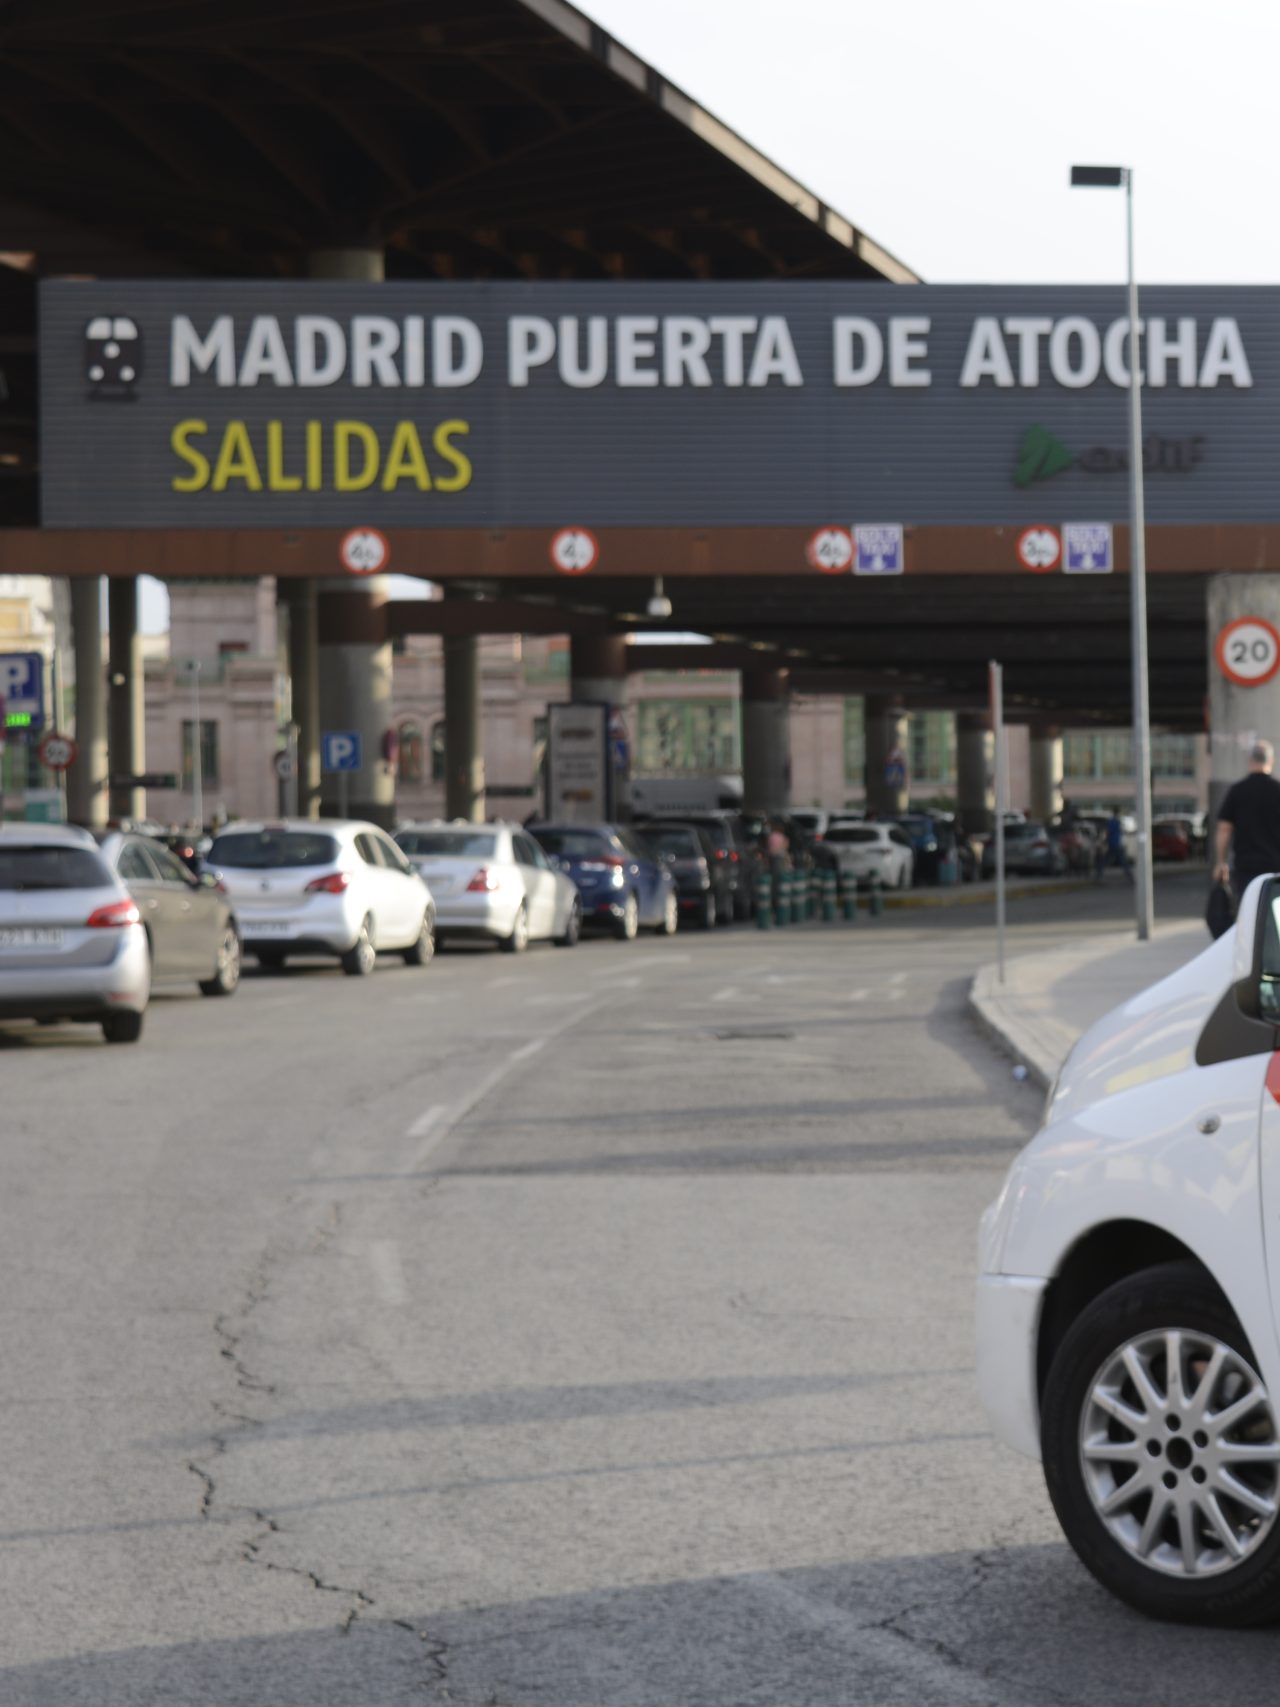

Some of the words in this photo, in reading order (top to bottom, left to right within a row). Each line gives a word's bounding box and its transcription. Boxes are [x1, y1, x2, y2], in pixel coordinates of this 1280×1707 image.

[170, 315, 484, 388] MADRID
[508, 316, 803, 388] PUERTA
[833, 316, 932, 388] DE
[959, 316, 1254, 388] ATOCHA
[170, 420, 473, 492] SALIDAS
[1231, 640, 1270, 663] 20
[329, 735, 354, 768] P
